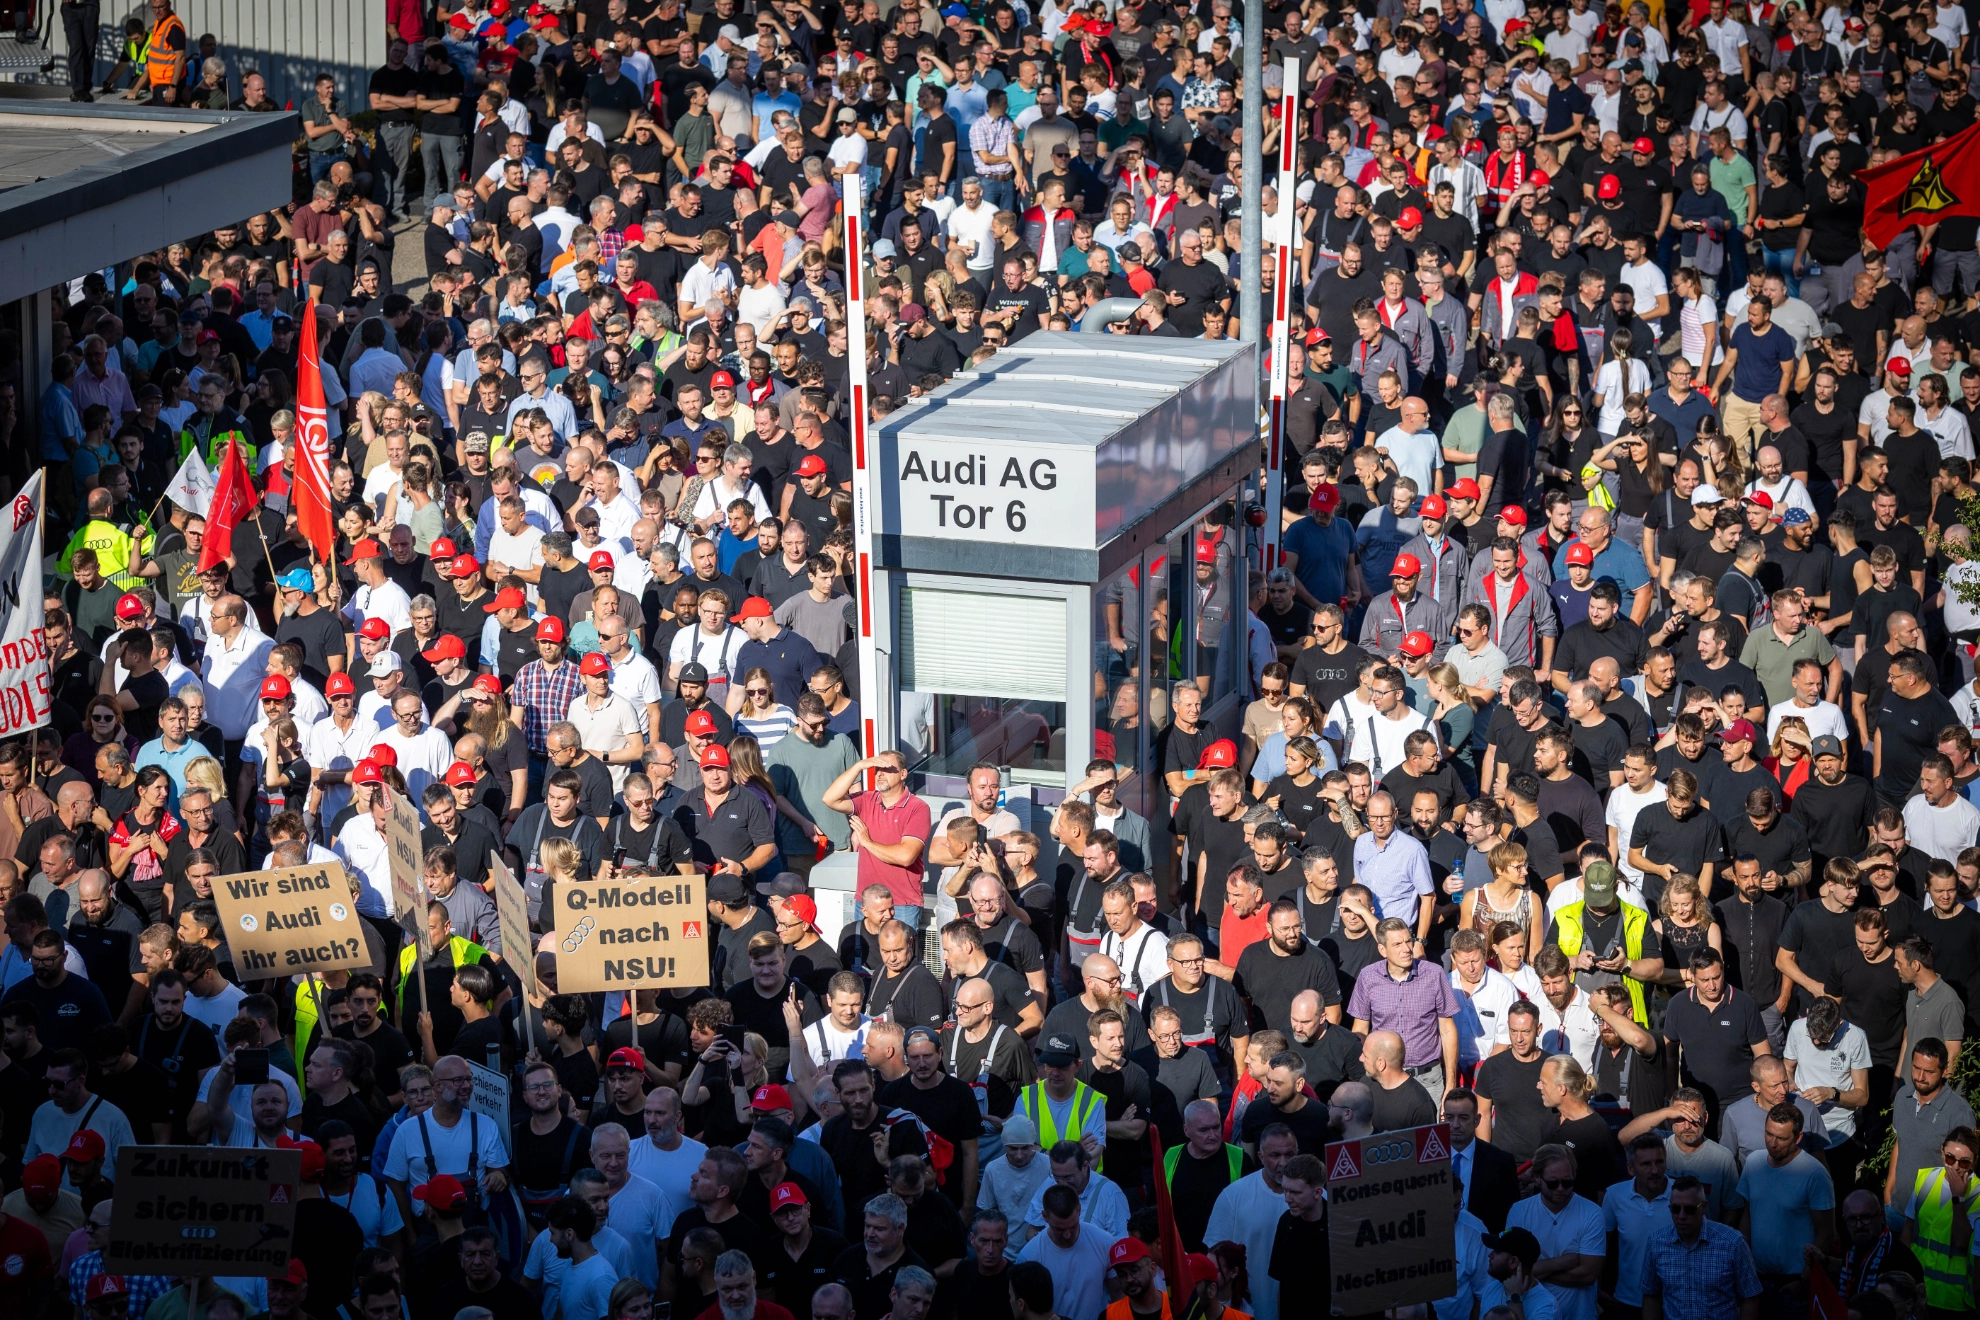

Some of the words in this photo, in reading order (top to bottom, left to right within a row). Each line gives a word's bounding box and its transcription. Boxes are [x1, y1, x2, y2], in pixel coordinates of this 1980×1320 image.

[900, 450, 986, 486] Audi
[999, 456, 1057, 491] AG
[180, 485, 198, 496] Audi
[930, 493, 994, 530] Tor
[1006, 499, 1027, 533] 6
[393, 808, 413, 837] Audi
[396, 838, 416, 870] NSU
[226, 879, 269, 900] Wir
[277, 870, 331, 894] sind
[566, 884, 691, 911] Q-Modell
[265, 905, 322, 932] Audi
[599, 921, 670, 945] nach
[241, 949, 277, 970] ihr
[285, 937, 360, 966] auch?
[604, 956, 676, 981] NSU!
[473, 1091, 502, 1113] verkehr
[131, 1152, 270, 1181] Zukunft
[1332, 1168, 1448, 1205] Konsequent
[134, 1195, 265, 1223] sichern
[1354, 1209, 1427, 1248] Audi
[109, 1240, 288, 1267] Elektrifizierung
[1336, 1257, 1454, 1293] Neckarsulm
